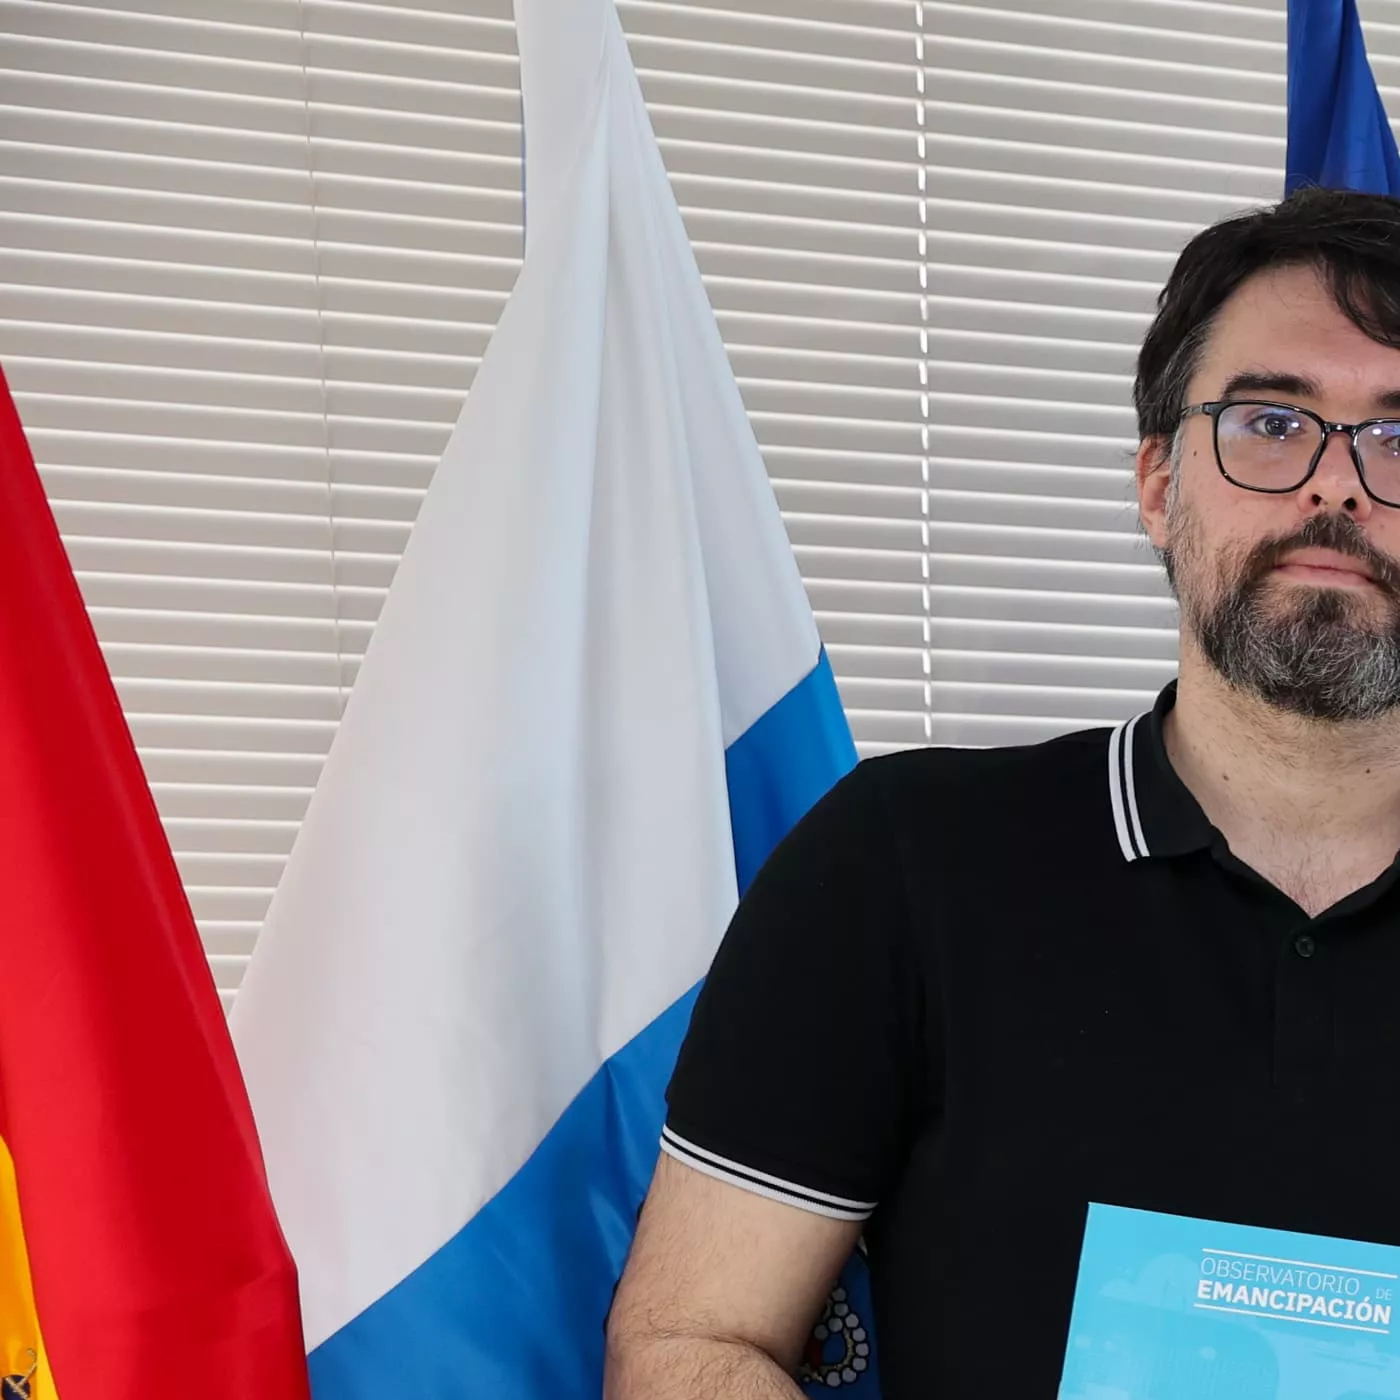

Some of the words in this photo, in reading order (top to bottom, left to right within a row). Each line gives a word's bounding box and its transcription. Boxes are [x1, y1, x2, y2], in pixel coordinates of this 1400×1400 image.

[1201, 1257, 1360, 1296] OBSERVATORIO
[1375, 1287, 1393, 1301] DE
[1197, 1279, 1392, 1324] EMANCIPACIÓN
